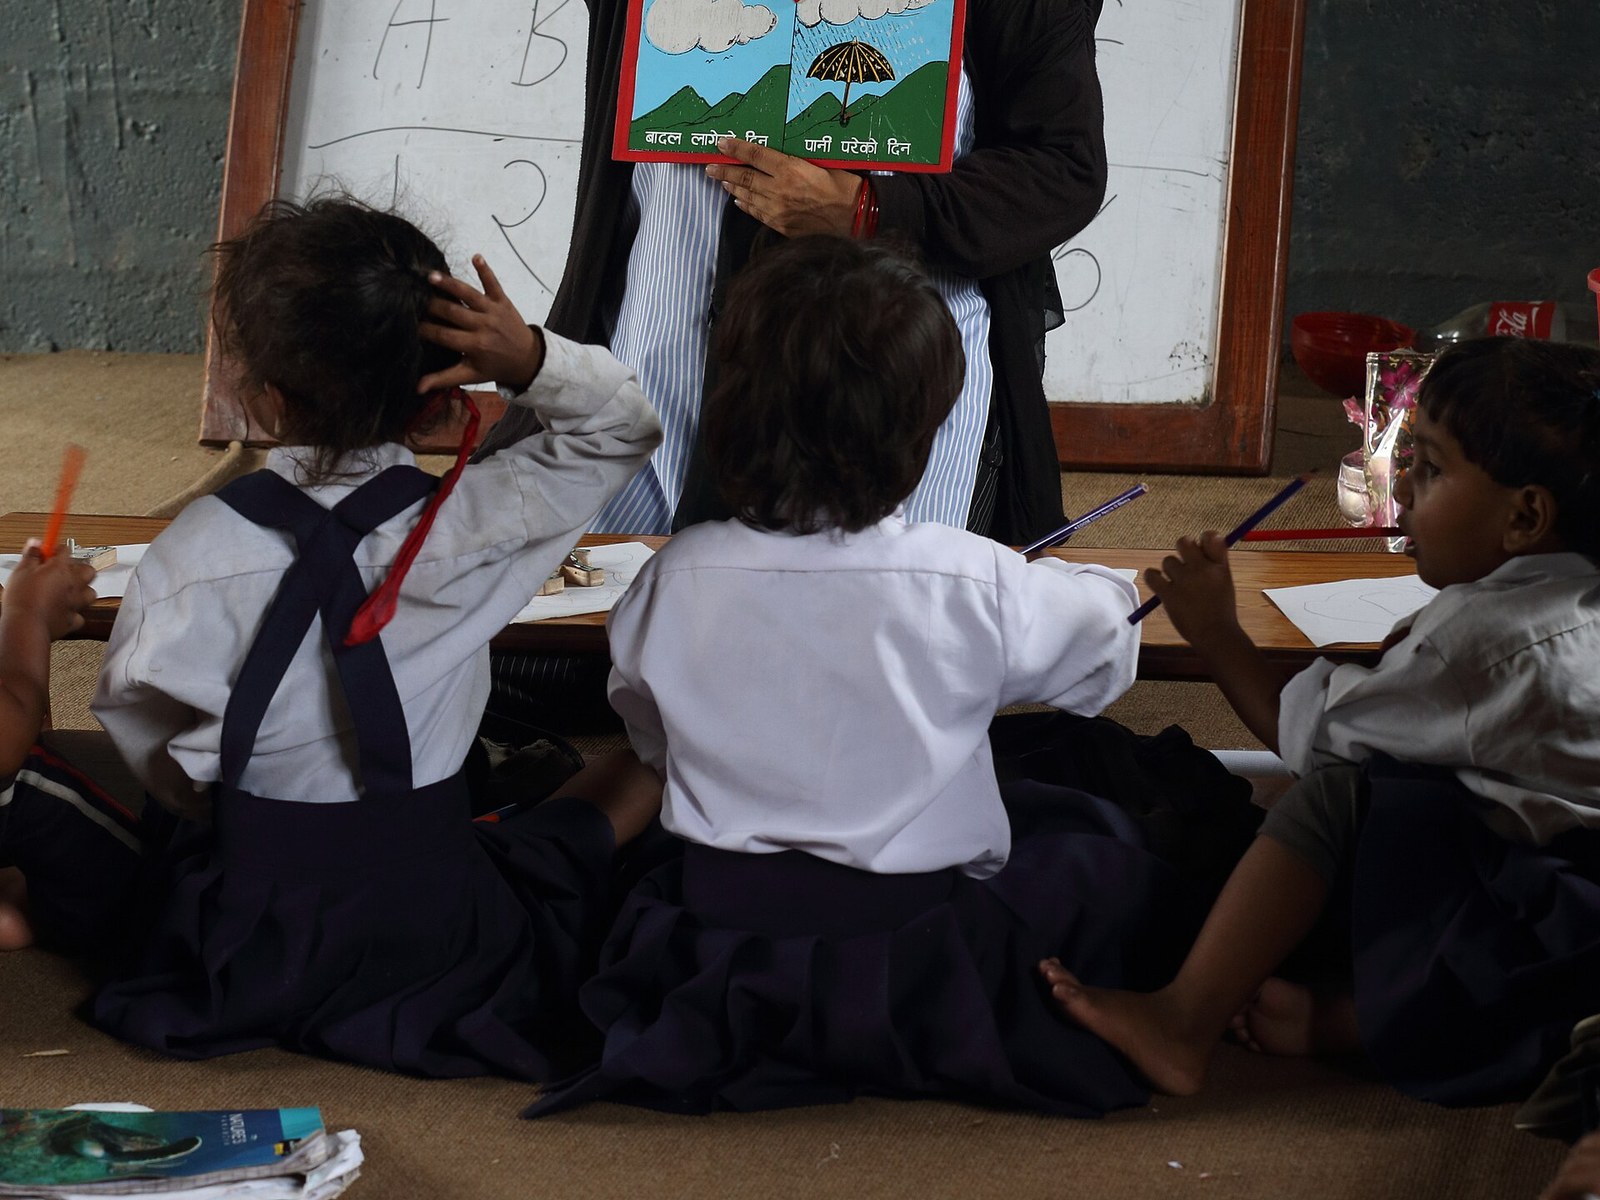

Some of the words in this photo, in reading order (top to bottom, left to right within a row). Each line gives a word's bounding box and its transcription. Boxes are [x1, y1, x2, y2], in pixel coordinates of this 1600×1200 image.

[645, 130, 683, 146] बादल
[804, 135, 833, 153] पानी
[840, 136, 879, 155] परेको
[887, 138, 913, 156] दिन
